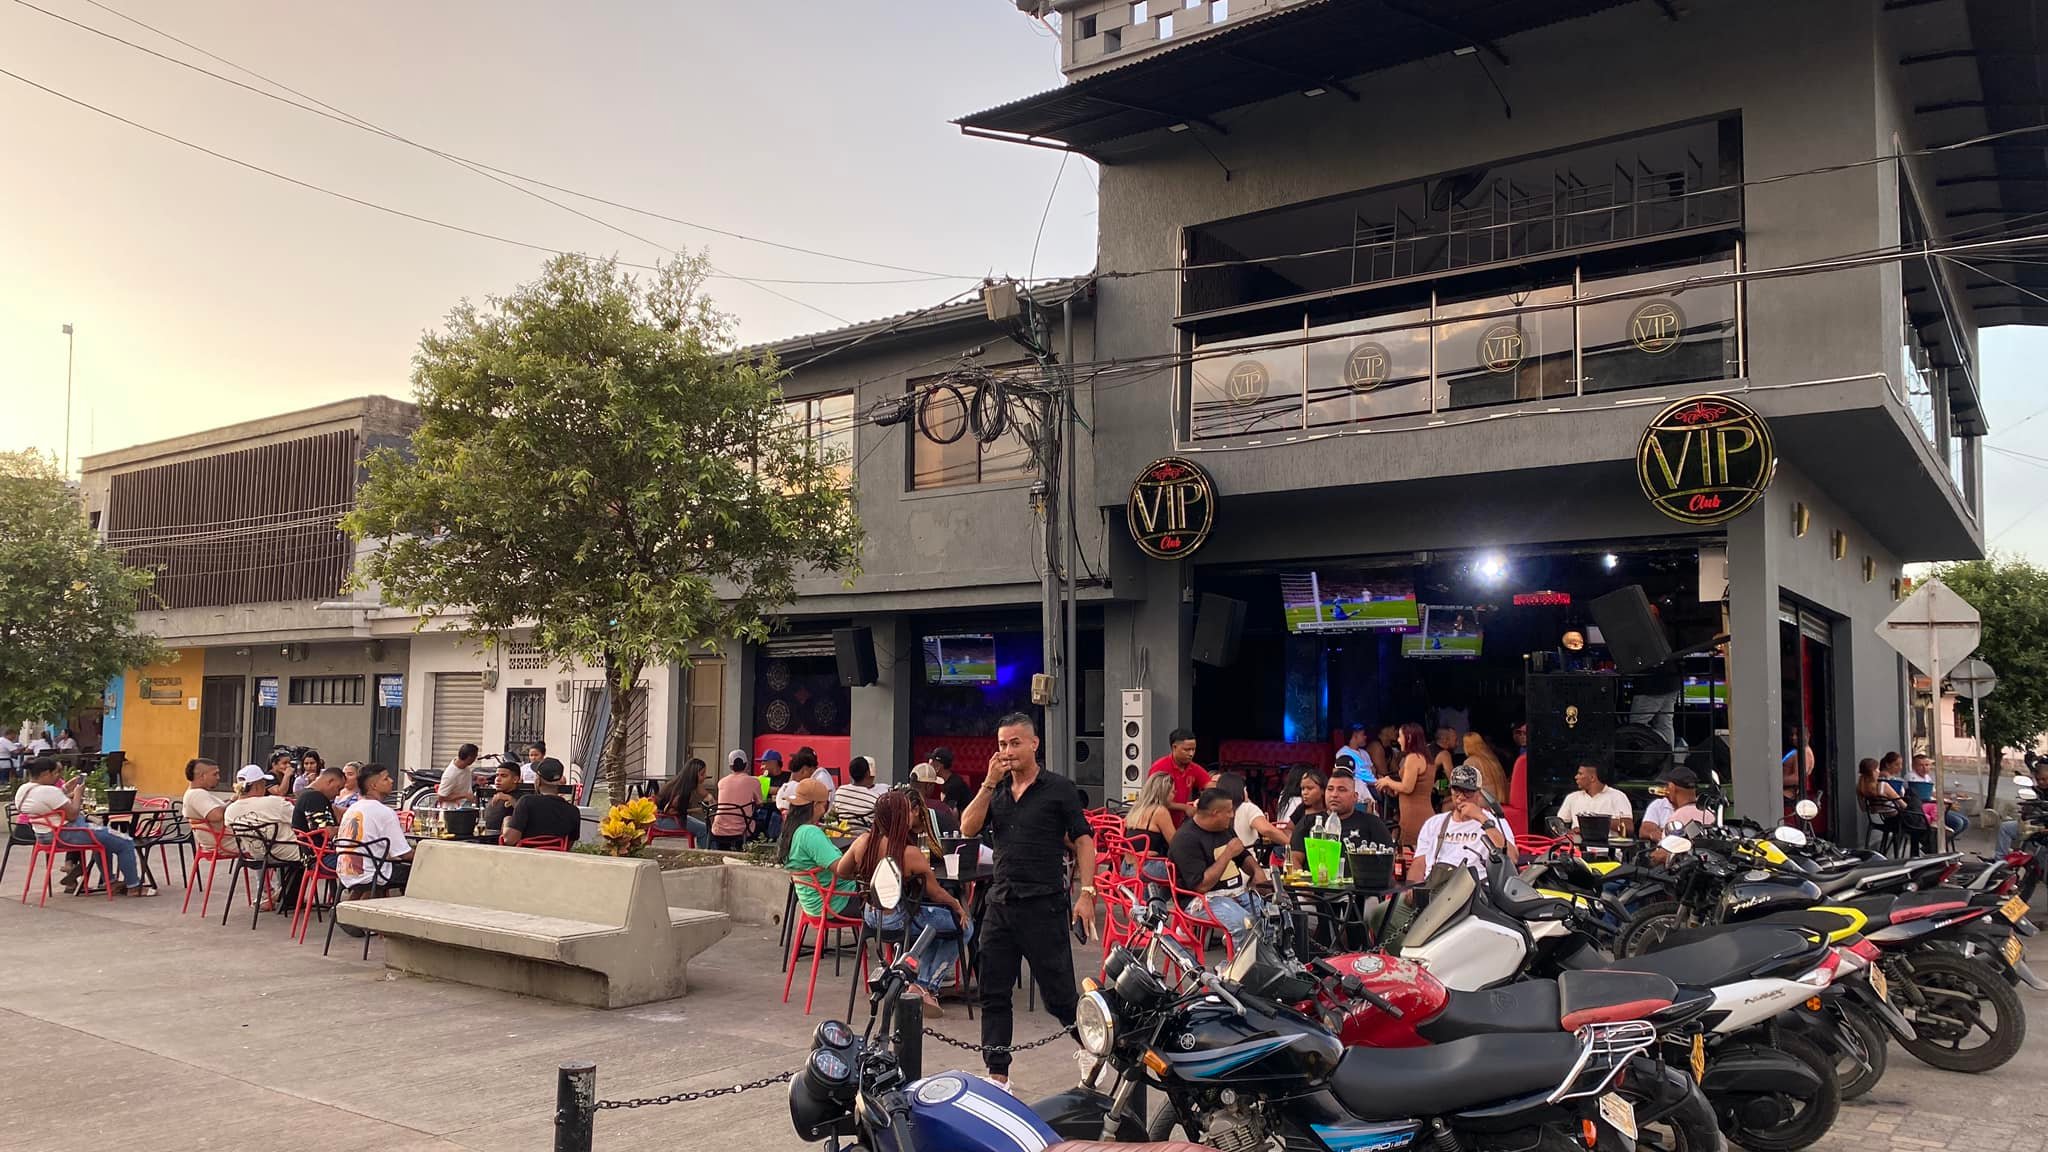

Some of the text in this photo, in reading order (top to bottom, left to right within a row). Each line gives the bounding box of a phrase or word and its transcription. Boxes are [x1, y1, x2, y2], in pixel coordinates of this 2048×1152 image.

[1636, 315, 1675, 340] VIP
[1486, 336, 1520, 360] VIP
[1352, 357, 1383, 379] VIP
[1232, 373, 1260, 395] VIP
[1650, 425, 1755, 489] VIP
[1133, 482, 1203, 532] VIP
[1688, 494, 1721, 511] Club
[1160, 536, 1182, 550] Club
